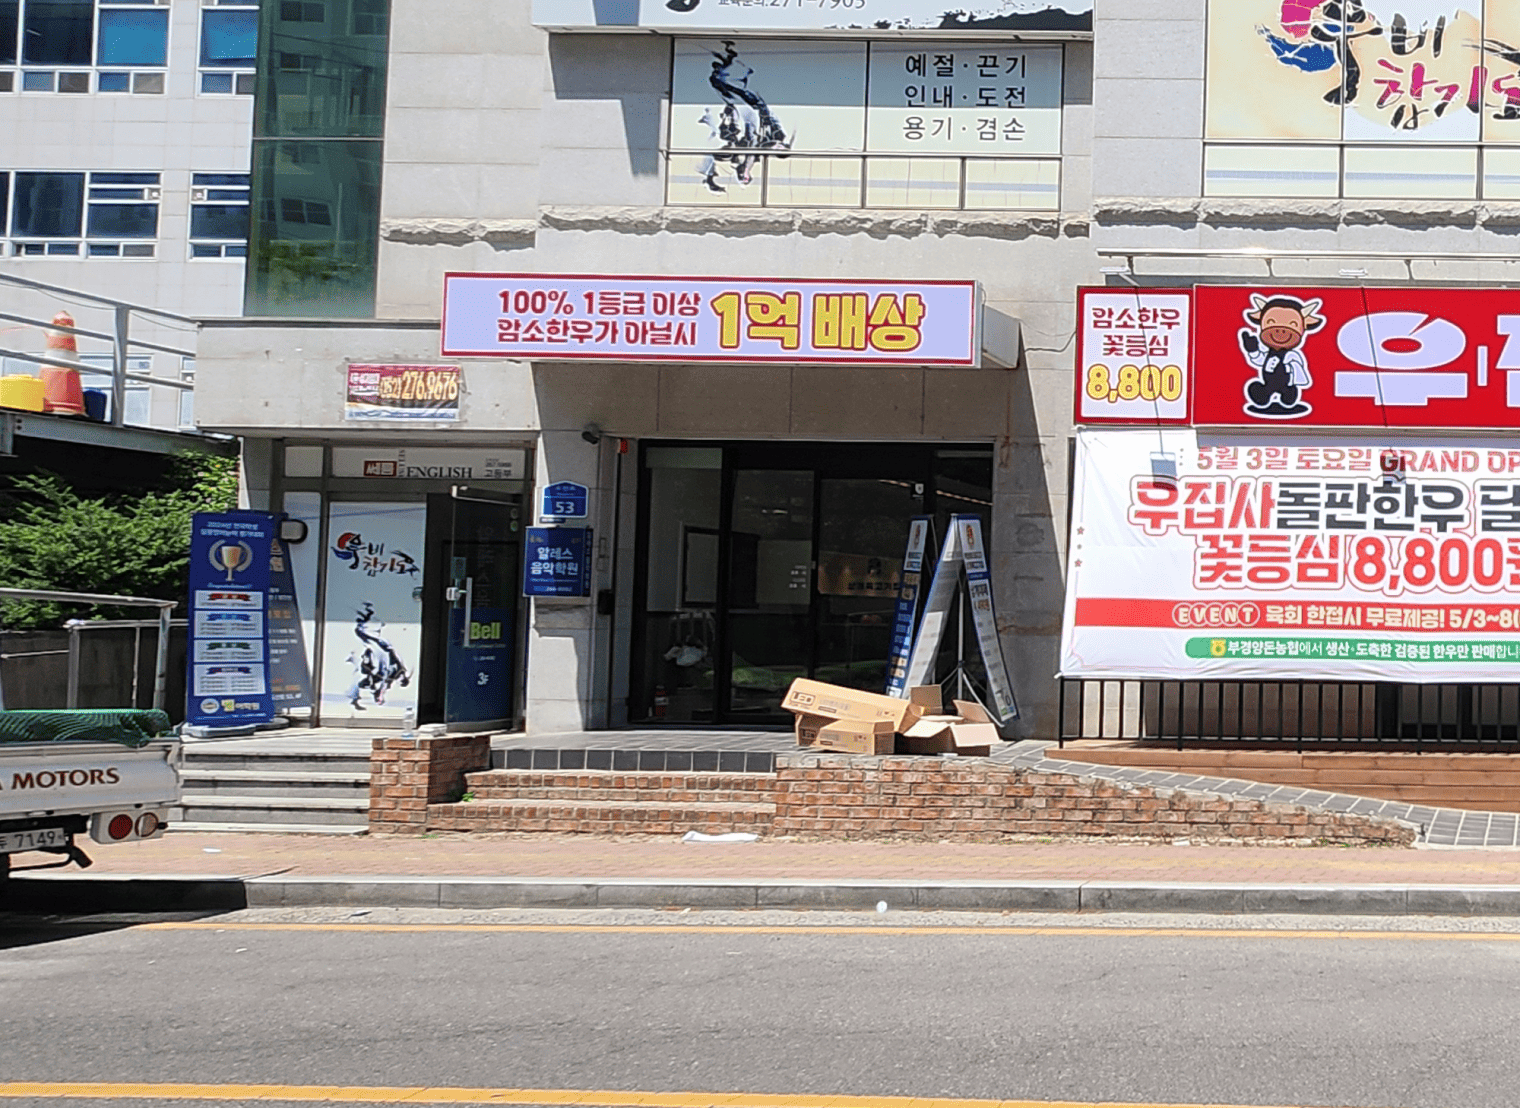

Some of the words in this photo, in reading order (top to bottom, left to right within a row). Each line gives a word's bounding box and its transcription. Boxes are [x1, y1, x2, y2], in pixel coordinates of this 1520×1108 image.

[498, 290, 574, 315] 100%
[583, 291, 646, 316] 1등급
[652, 292, 701, 317] 이상
[710, 291, 800, 350] 1억
[812, 292, 926, 352] 배상
[1091, 307, 1181, 330] 암소한우
[497, 318, 619, 344] 암소한우가
[625, 320, 696, 346] 아닐시
[1102, 334, 1169, 357] 꽃등심
[1086, 363, 1183, 404] 8,800
[1196, 445, 1239, 470] 5월
[1245, 447, 1289, 471] 3일
[1295, 447, 1372, 471] 토요일
[1379, 449, 1480, 473] GRAND
[406, 466, 473, 478] ENGLISH
[554, 501, 575, 514] 53
[529, 561, 579, 576] 음악학원
[1199, 534, 1340, 584] 꽃등심
[1176, 605, 1256, 624] EVENT
[1265, 605, 1303, 625] 육회
[1306, 605, 1362, 627] 한접시
[1365, 607, 1445, 629] 무료제공!
[469, 621, 502, 640] Bell
[1394, 643, 1431, 660] 검증된
[1432, 643, 1470, 660] 한우만
[476, 671, 490, 686] 3F
[11, 767, 120, 790] MOTORS
[14, 830, 56, 849] 7149
